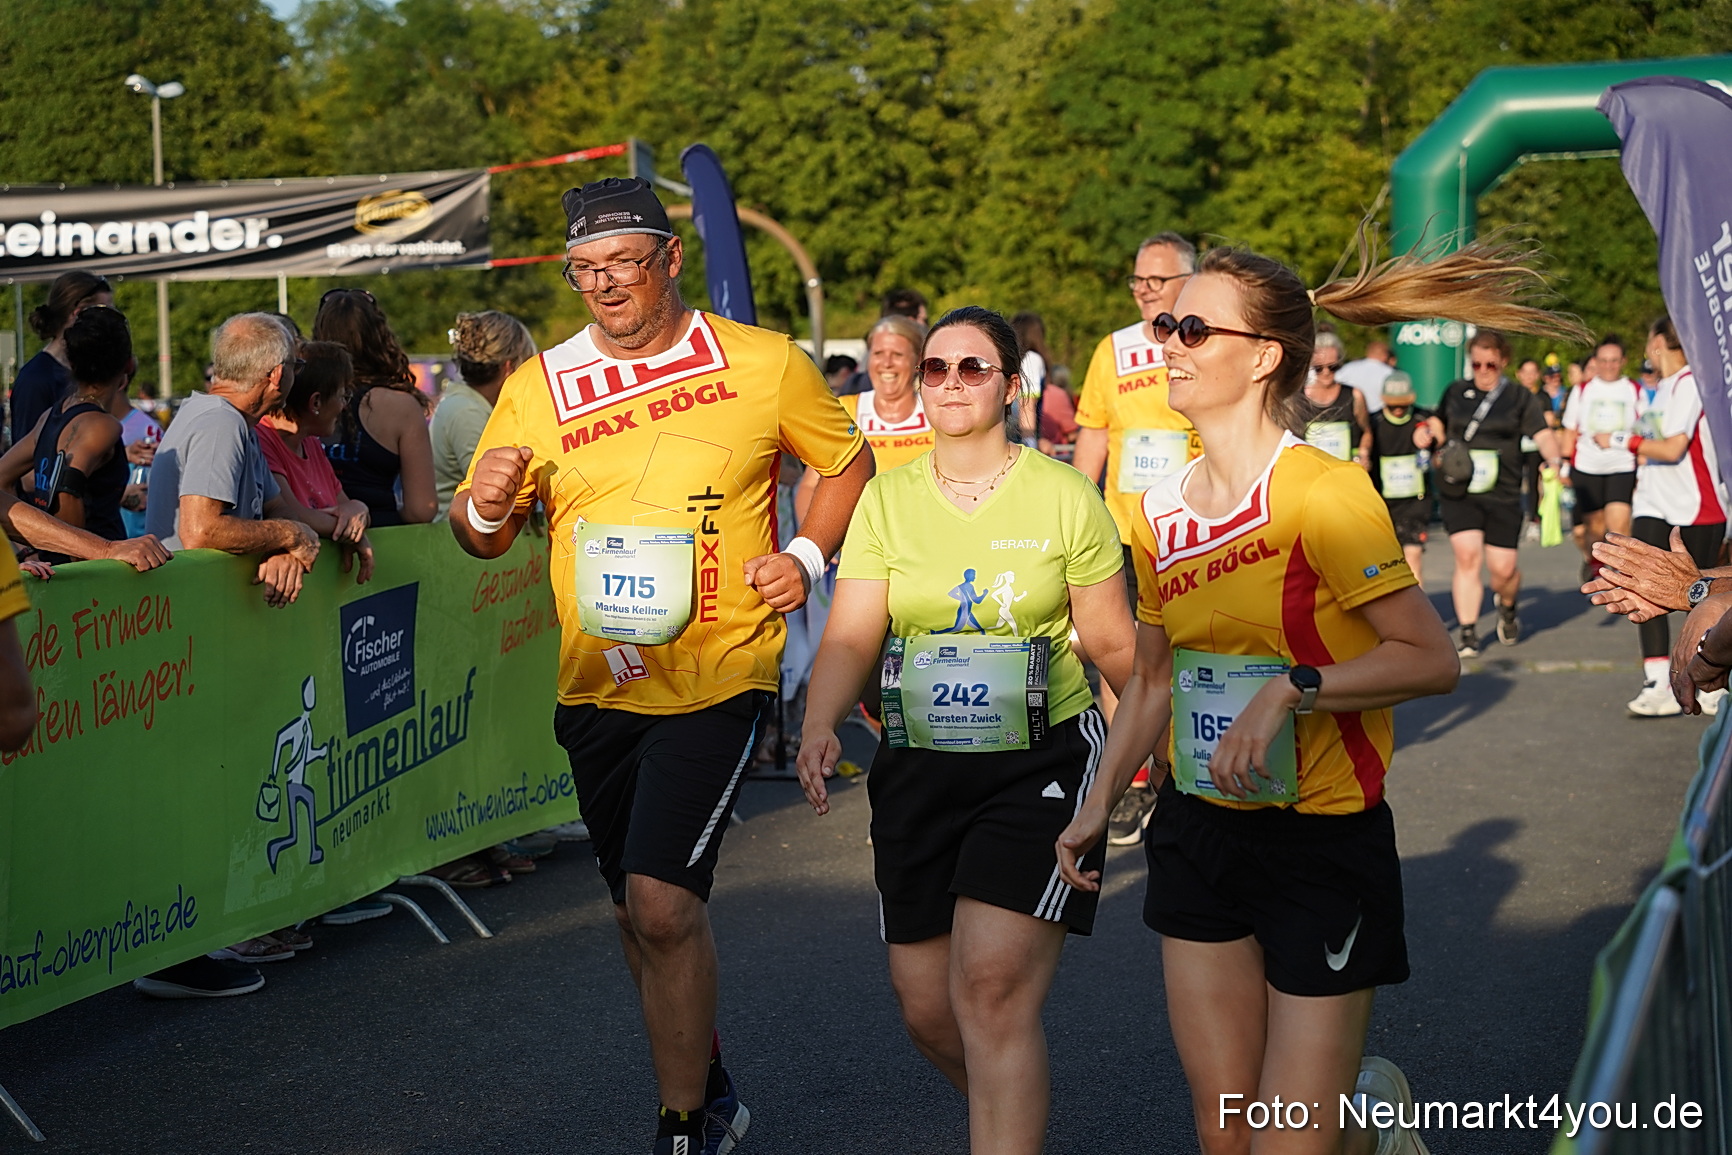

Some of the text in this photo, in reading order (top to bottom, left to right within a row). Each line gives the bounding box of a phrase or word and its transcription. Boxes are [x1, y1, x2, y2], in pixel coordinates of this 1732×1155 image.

[0, 210, 283, 257] einander.
[1397, 323, 1441, 346] AOK
[1118, 375, 1158, 395] MAX
[560, 381, 738, 454] MAX BÖGL
[869, 440, 887, 448] AX
[1133, 455, 1169, 469] 1867
[601, 547, 637, 556] Firmenlauf
[991, 539, 1039, 550] BERATA
[472, 543, 543, 614] Gesunde
[1158, 537, 1281, 608] MAX BÖGL
[602, 573, 656, 599] 1715
[595, 601, 669, 616] Markus Kellner
[72, 594, 172, 660] Firmen
[355, 629, 404, 665] Fischer
[1028, 643, 1036, 669] RABATT
[360, 651, 401, 677] AUTOMOBILE
[933, 656, 970, 665] Firmenlauf
[93, 635, 195, 731] länger!
[932, 682, 990, 707] 242
[1193, 681, 1226, 690] Firmenlauf
[927, 713, 1002, 723] Carsten Zwick
[1032, 710, 1042, 741] HILTL
[1191, 712, 1233, 742] 165
[327, 666, 476, 813] firmenlauf
[1193, 748, 1211, 760] Julia
[333, 787, 390, 848] neumarkt
[426, 771, 575, 842] www.firmenlauf-obe
